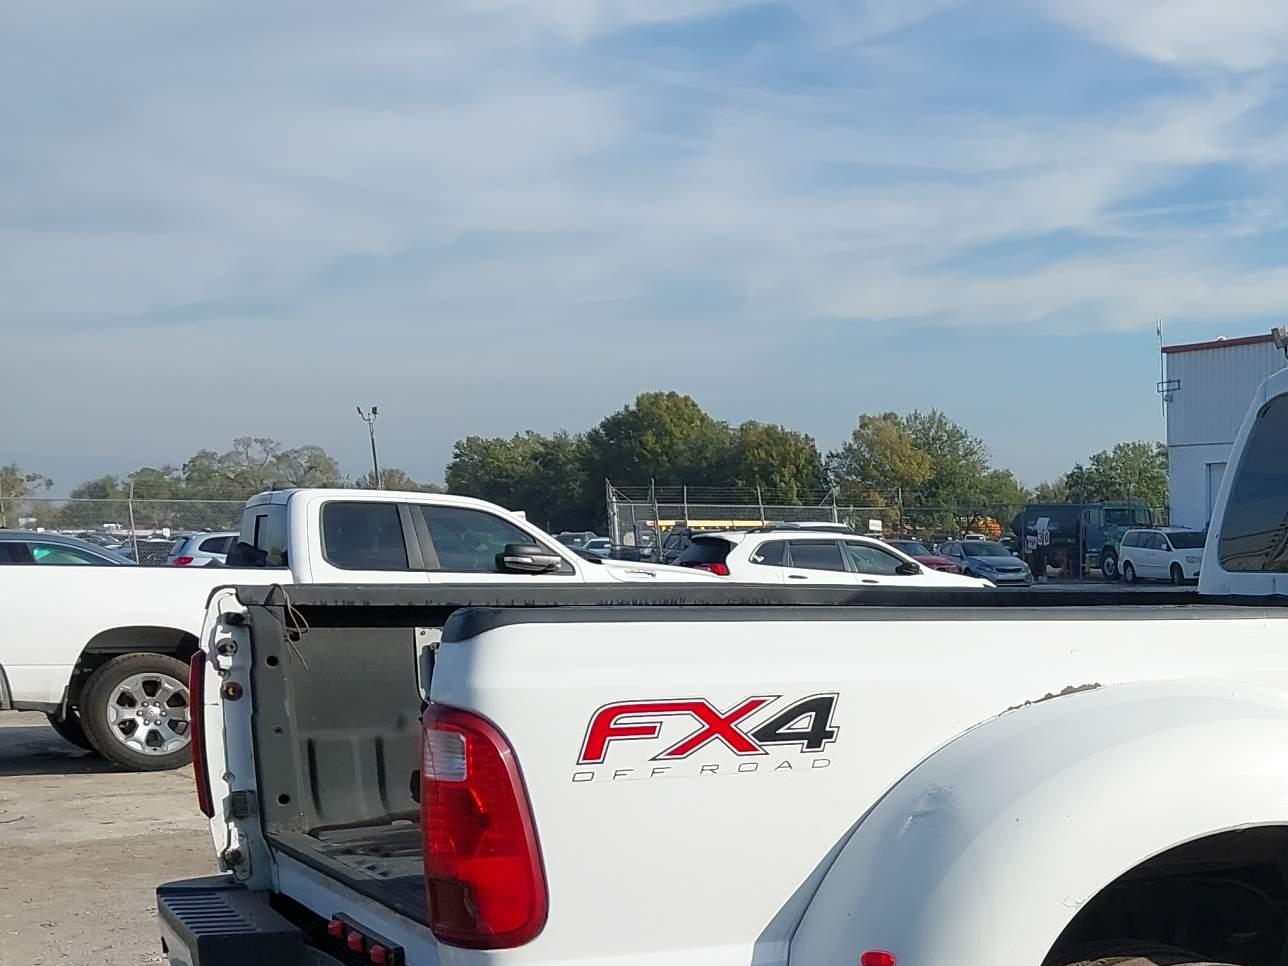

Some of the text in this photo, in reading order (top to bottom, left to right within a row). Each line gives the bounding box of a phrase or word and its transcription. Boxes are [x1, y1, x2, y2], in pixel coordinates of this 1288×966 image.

[576, 692, 840, 765] FX4
[571, 758, 831, 782] OFF ROAD
